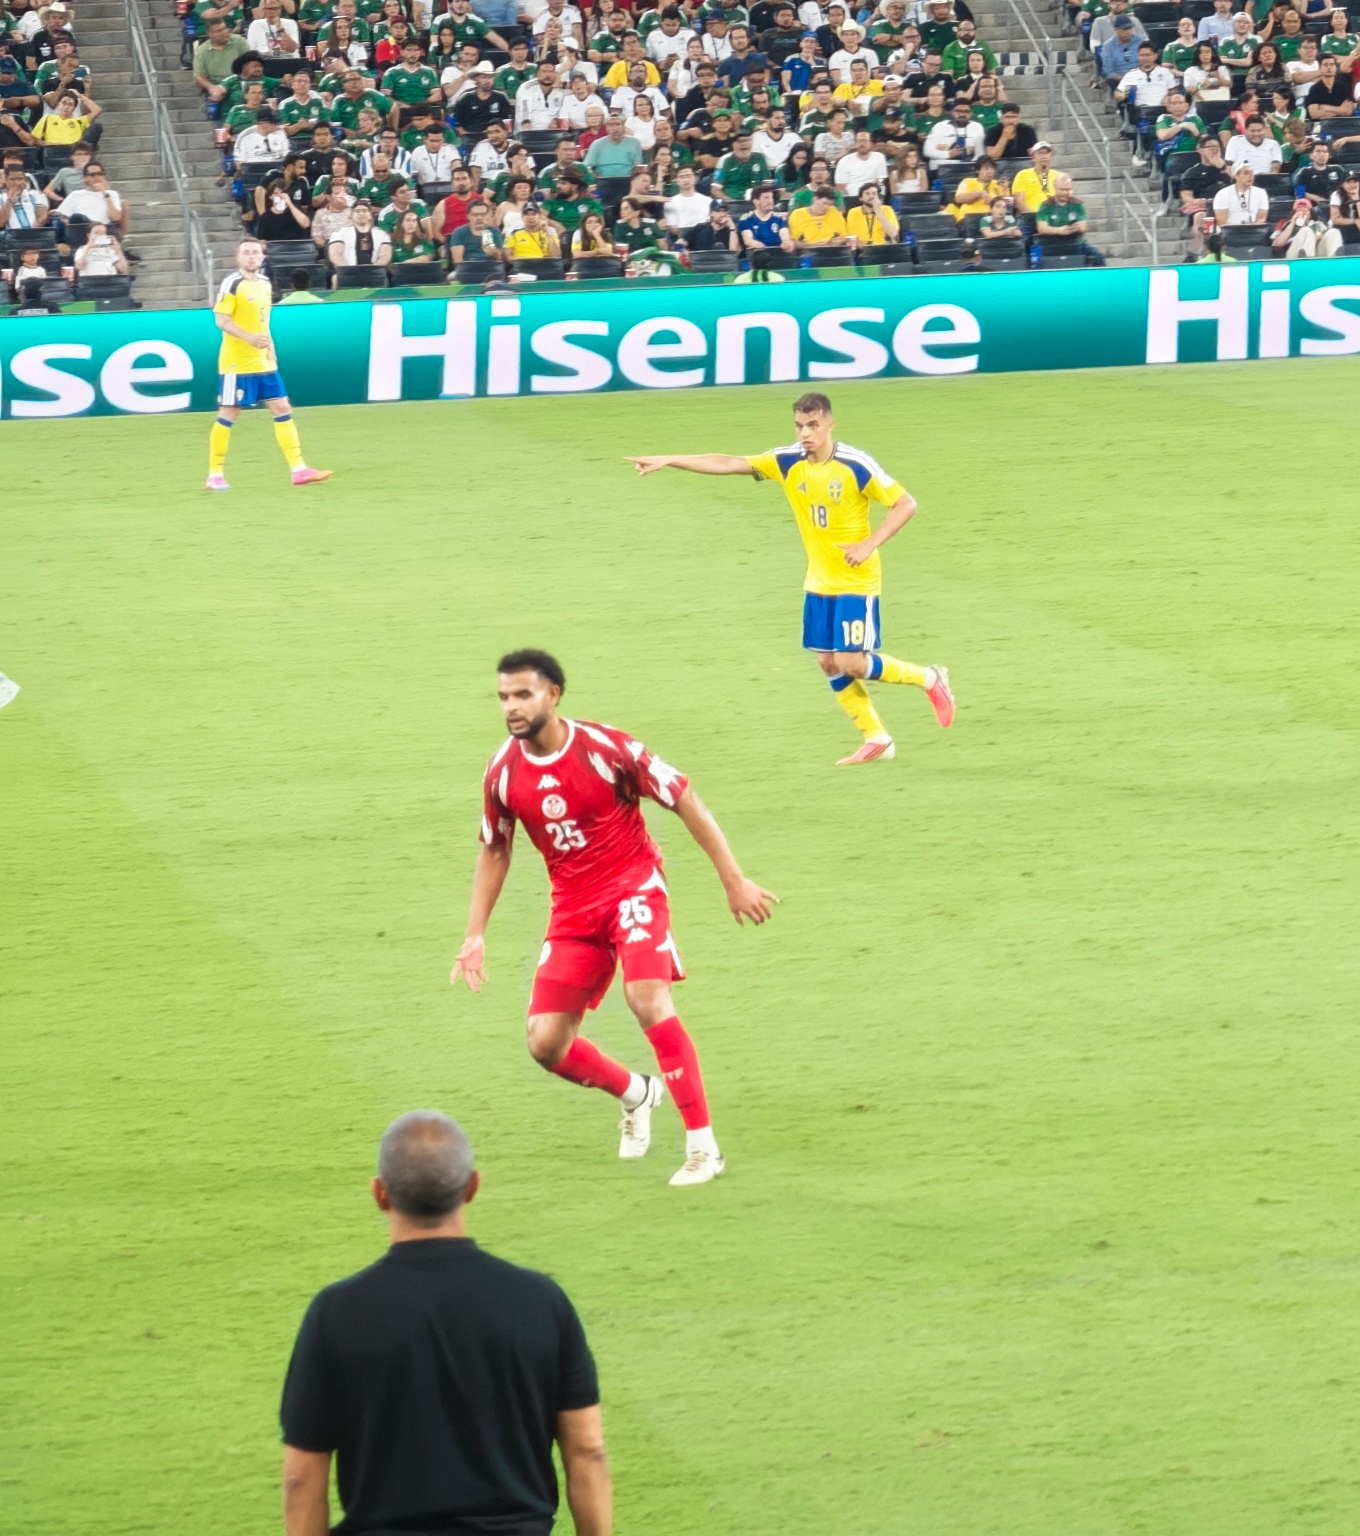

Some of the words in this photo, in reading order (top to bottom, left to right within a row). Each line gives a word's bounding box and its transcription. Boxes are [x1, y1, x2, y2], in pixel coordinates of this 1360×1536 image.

[367, 298, 982, 402] Hisense
[810, 503, 828, 529] 18
[841, 618, 865, 647] 18
[545, 819, 588, 852] 25
[618, 894, 653, 929] 25
